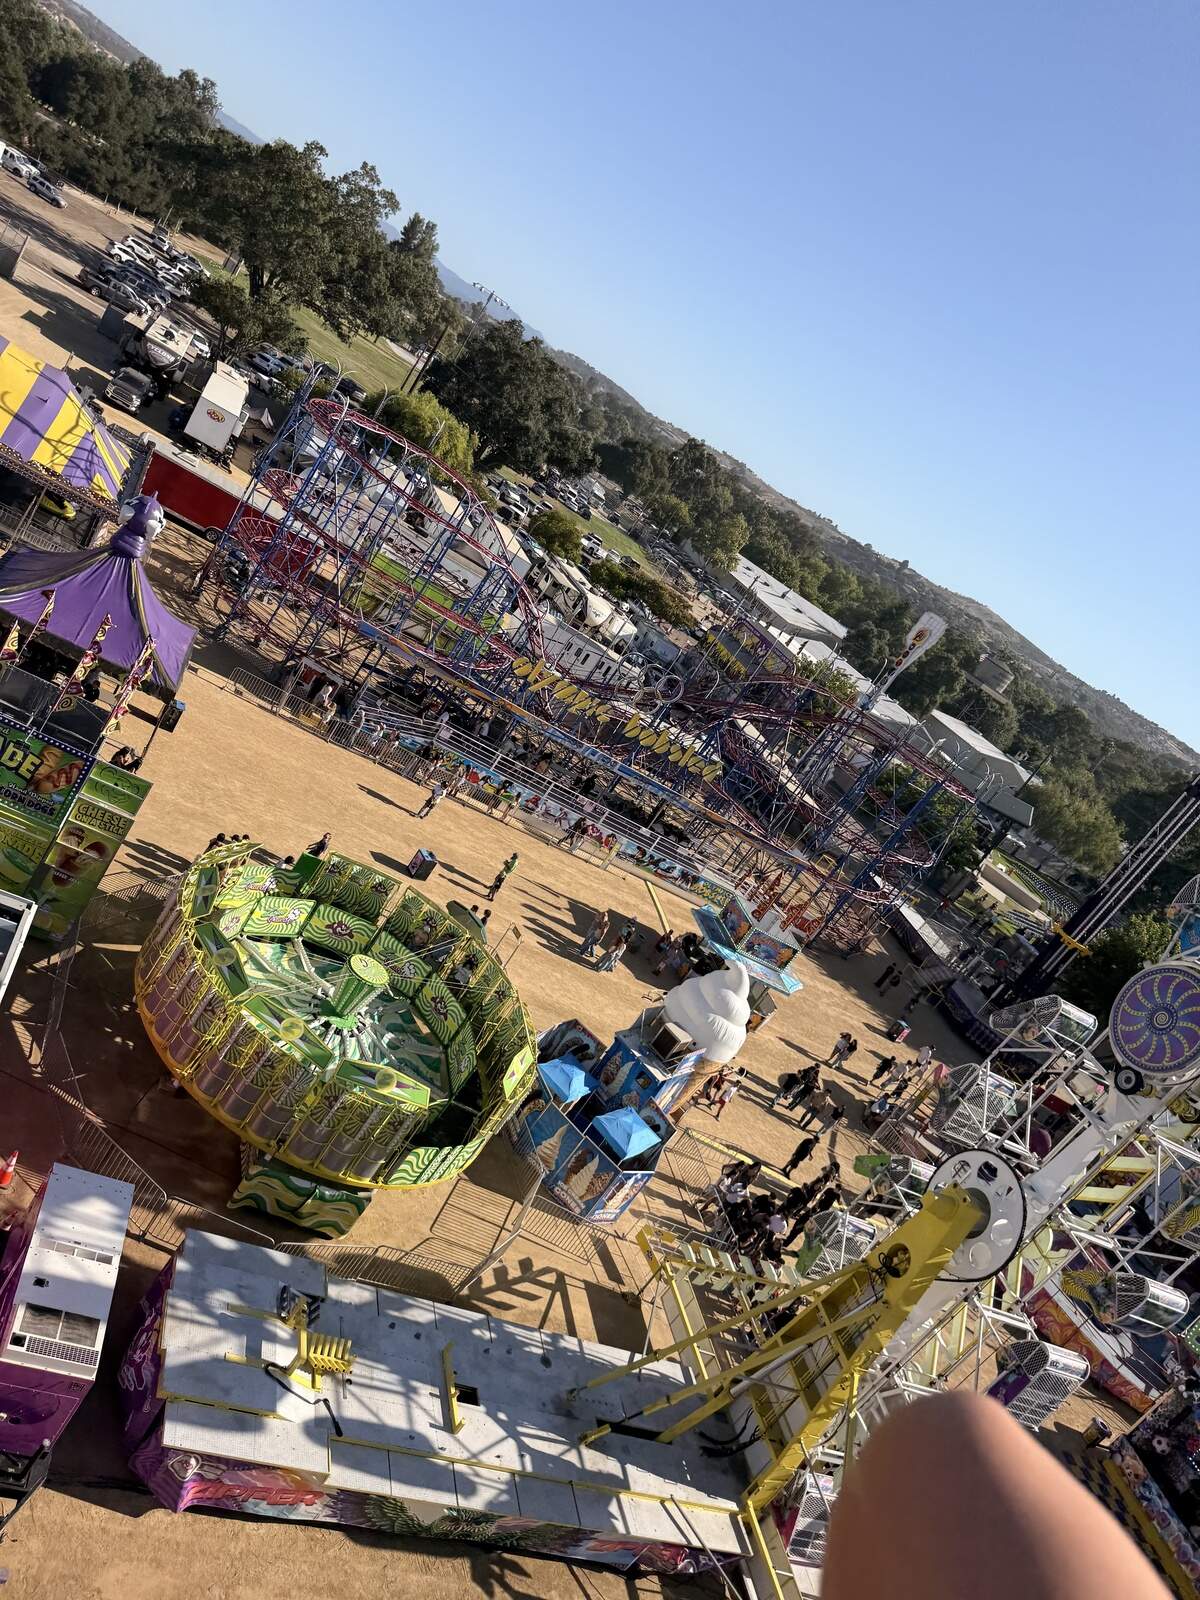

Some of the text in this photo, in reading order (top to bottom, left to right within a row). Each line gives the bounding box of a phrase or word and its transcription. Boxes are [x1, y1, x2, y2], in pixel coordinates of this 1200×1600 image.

[74, 812, 89, 825] ON
[98, 820, 126, 837] STICK
[77, 803, 129, 828] CHEESE
